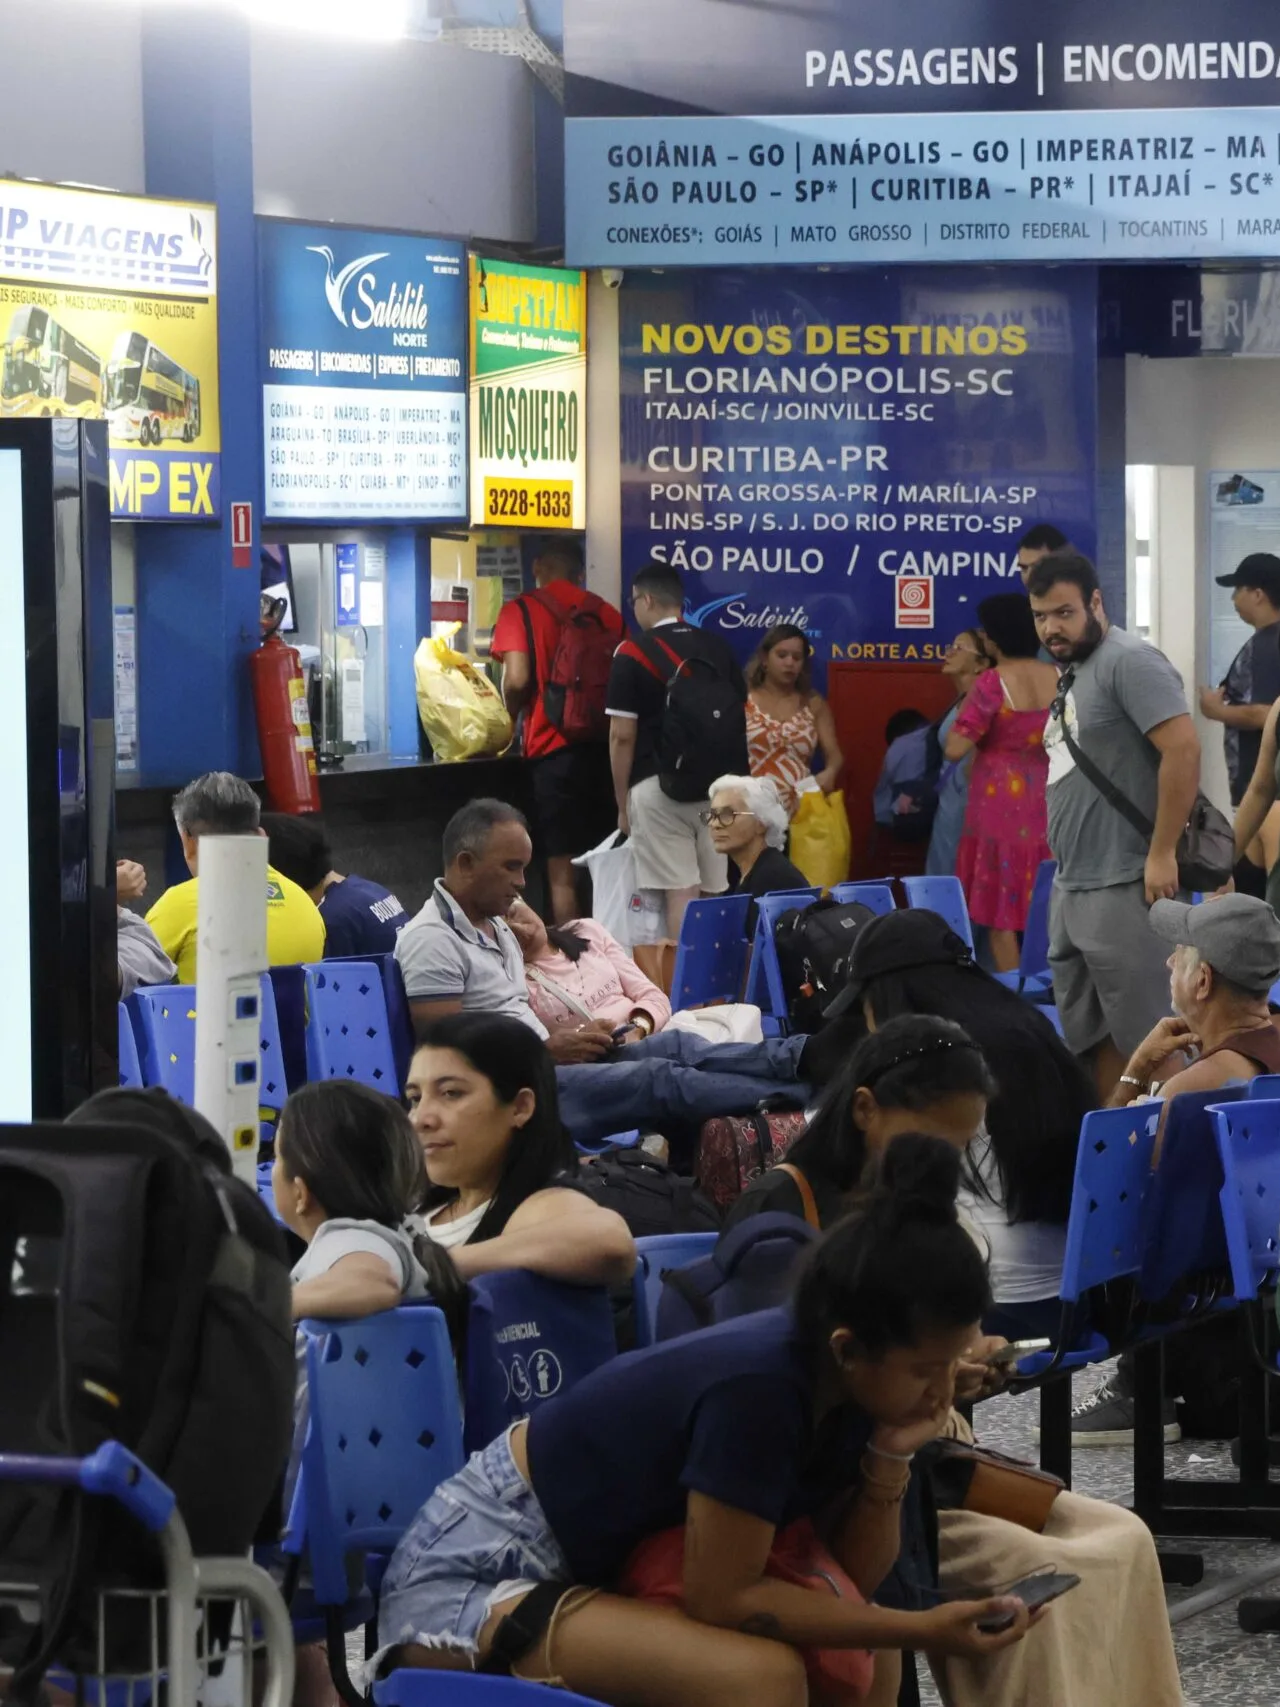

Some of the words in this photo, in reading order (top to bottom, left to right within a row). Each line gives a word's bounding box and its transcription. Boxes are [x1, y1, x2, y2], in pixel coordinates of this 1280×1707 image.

[805, 46, 1018, 88] PASSAGENS
[607, 139, 717, 168] GOIÂNIA
[748, 143, 785, 167] GO
[811, 137, 941, 166] ANÁPOLIS
[972, 140, 1009, 164] GO
[1037, 136, 1194, 162] IMPERATRIZ
[1226, 135, 1266, 159] MA
[608, 177, 659, 208] SÃO
[672, 180, 757, 208] PAULO
[871, 177, 991, 206] CURITIBA
[1108, 168, 1191, 199] ITAJAÍ
[39, 219, 184, 259] VIAGENS
[714, 223, 763, 244] GOIÁS
[790, 225, 837, 243] MATO
[848, 224, 912, 242] GROSSO
[940, 222, 1010, 241] DISTRITO
[1022, 221, 1091, 240] FEDERAL
[1118, 219, 1208, 238] TOCANTINS
[11, 289, 59, 308] SEGURANÇA
[65, 295, 84, 311] MAIS
[87, 296, 127, 313] CONFORTO
[133, 301, 153, 316] MAIS
[154, 303, 195, 320] QUALIDADE
[351, 273, 428, 330] Satélite
[393, 333, 428, 348] NORTE
[642, 323, 792, 356] NOVOS
[806, 324, 1027, 357] DESTINOS
[269, 349, 314, 371] PASSAGENS
[321, 352, 371, 374] ENCOMENDAS
[378, 354, 409, 375] EXPRESS
[415, 357, 460, 377] FRETAMENTO
[643, 363, 1014, 397] FLORIANÓPOLIS-SC
[334, 404, 370, 422] ANÁPOLIS
[399, 408, 440, 424] IMPERATRIZ
[450, 409, 461, 424] MA
[478, 385, 578, 468] MOSQUEIRO
[645, 401, 756, 423] ITAJAÍ-SC
[773, 403, 934, 423] JOINVILLE-SC
[323, 429, 332, 443] TO
[338, 428, 371, 444] BRASÍLIA
[271, 447, 286, 465] SÃO
[647, 444, 889, 473] CURITIBA-PR
[169, 461, 214, 515] EX
[489, 488, 571, 518] 3228-1333
[650, 484, 734, 502] PONTA
[738, 484, 878, 503] GROSSA-PR
[897, 481, 1037, 505] MARÍLIA-SP
[650, 512, 744, 532] LINS-SP
[762, 513, 783, 532] S.
[788, 513, 806, 532] J.
[813, 513, 849, 532] DO
[855, 513, 897, 532] RIO
[903, 513, 1023, 534] PRETO-SP
[650, 540, 714, 572] SÃO
[722, 546, 824, 574] PAULO
[832, 642, 899, 659] NORTE
[905, 643, 918, 659] A
